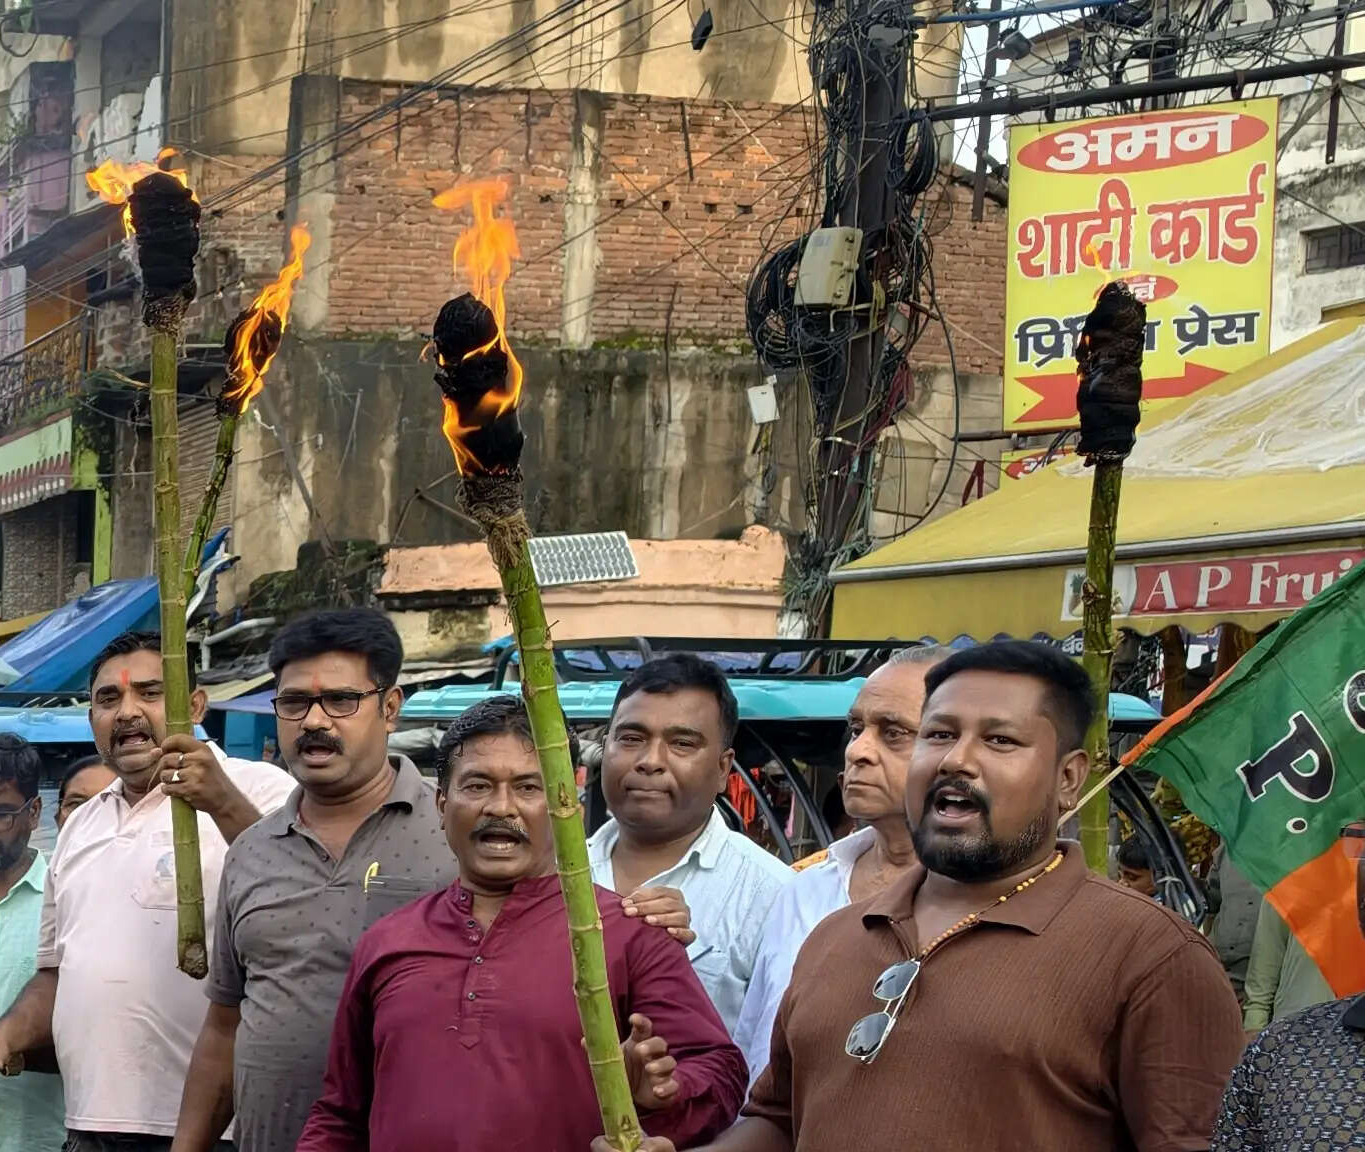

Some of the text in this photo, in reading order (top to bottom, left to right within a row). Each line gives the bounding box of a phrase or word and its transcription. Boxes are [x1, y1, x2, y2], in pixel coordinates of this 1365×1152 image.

[1046, 114, 1241, 171] अमन
[1018, 163, 1267, 278] शादी कार्ड
[1127, 276, 1157, 300] वं
[1173, 304, 1260, 356] प्रेस
[1143, 570, 1179, 611] A
[1195, 565, 1232, 608] P
